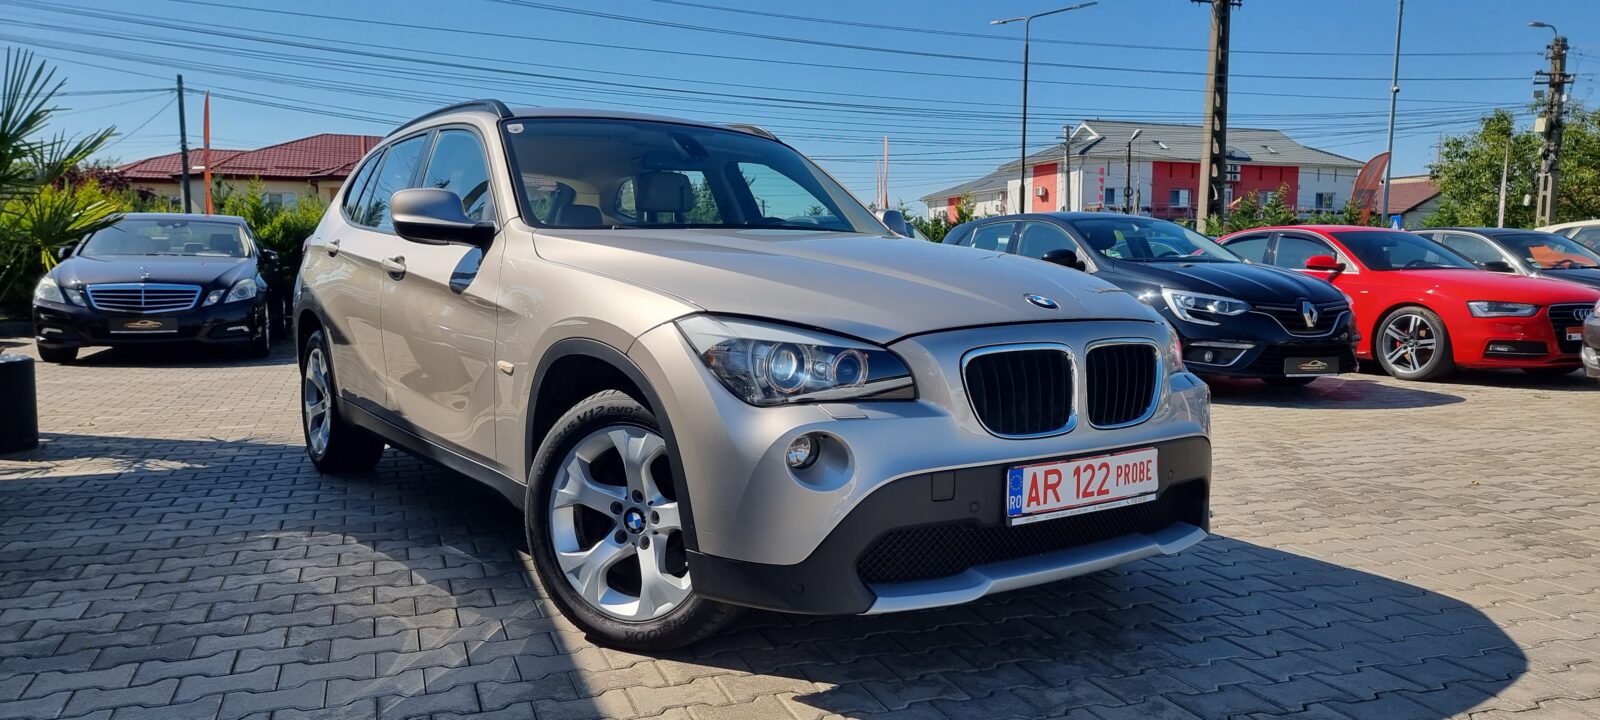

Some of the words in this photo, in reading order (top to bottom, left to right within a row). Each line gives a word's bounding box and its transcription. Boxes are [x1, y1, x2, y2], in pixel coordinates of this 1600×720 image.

[576, 404, 605, 422] V12
[1026, 469, 1062, 507] AR
[1073, 461, 1110, 500] 122
[1116, 459, 1152, 487] PROBE
[1009, 494, 1022, 509] RO
